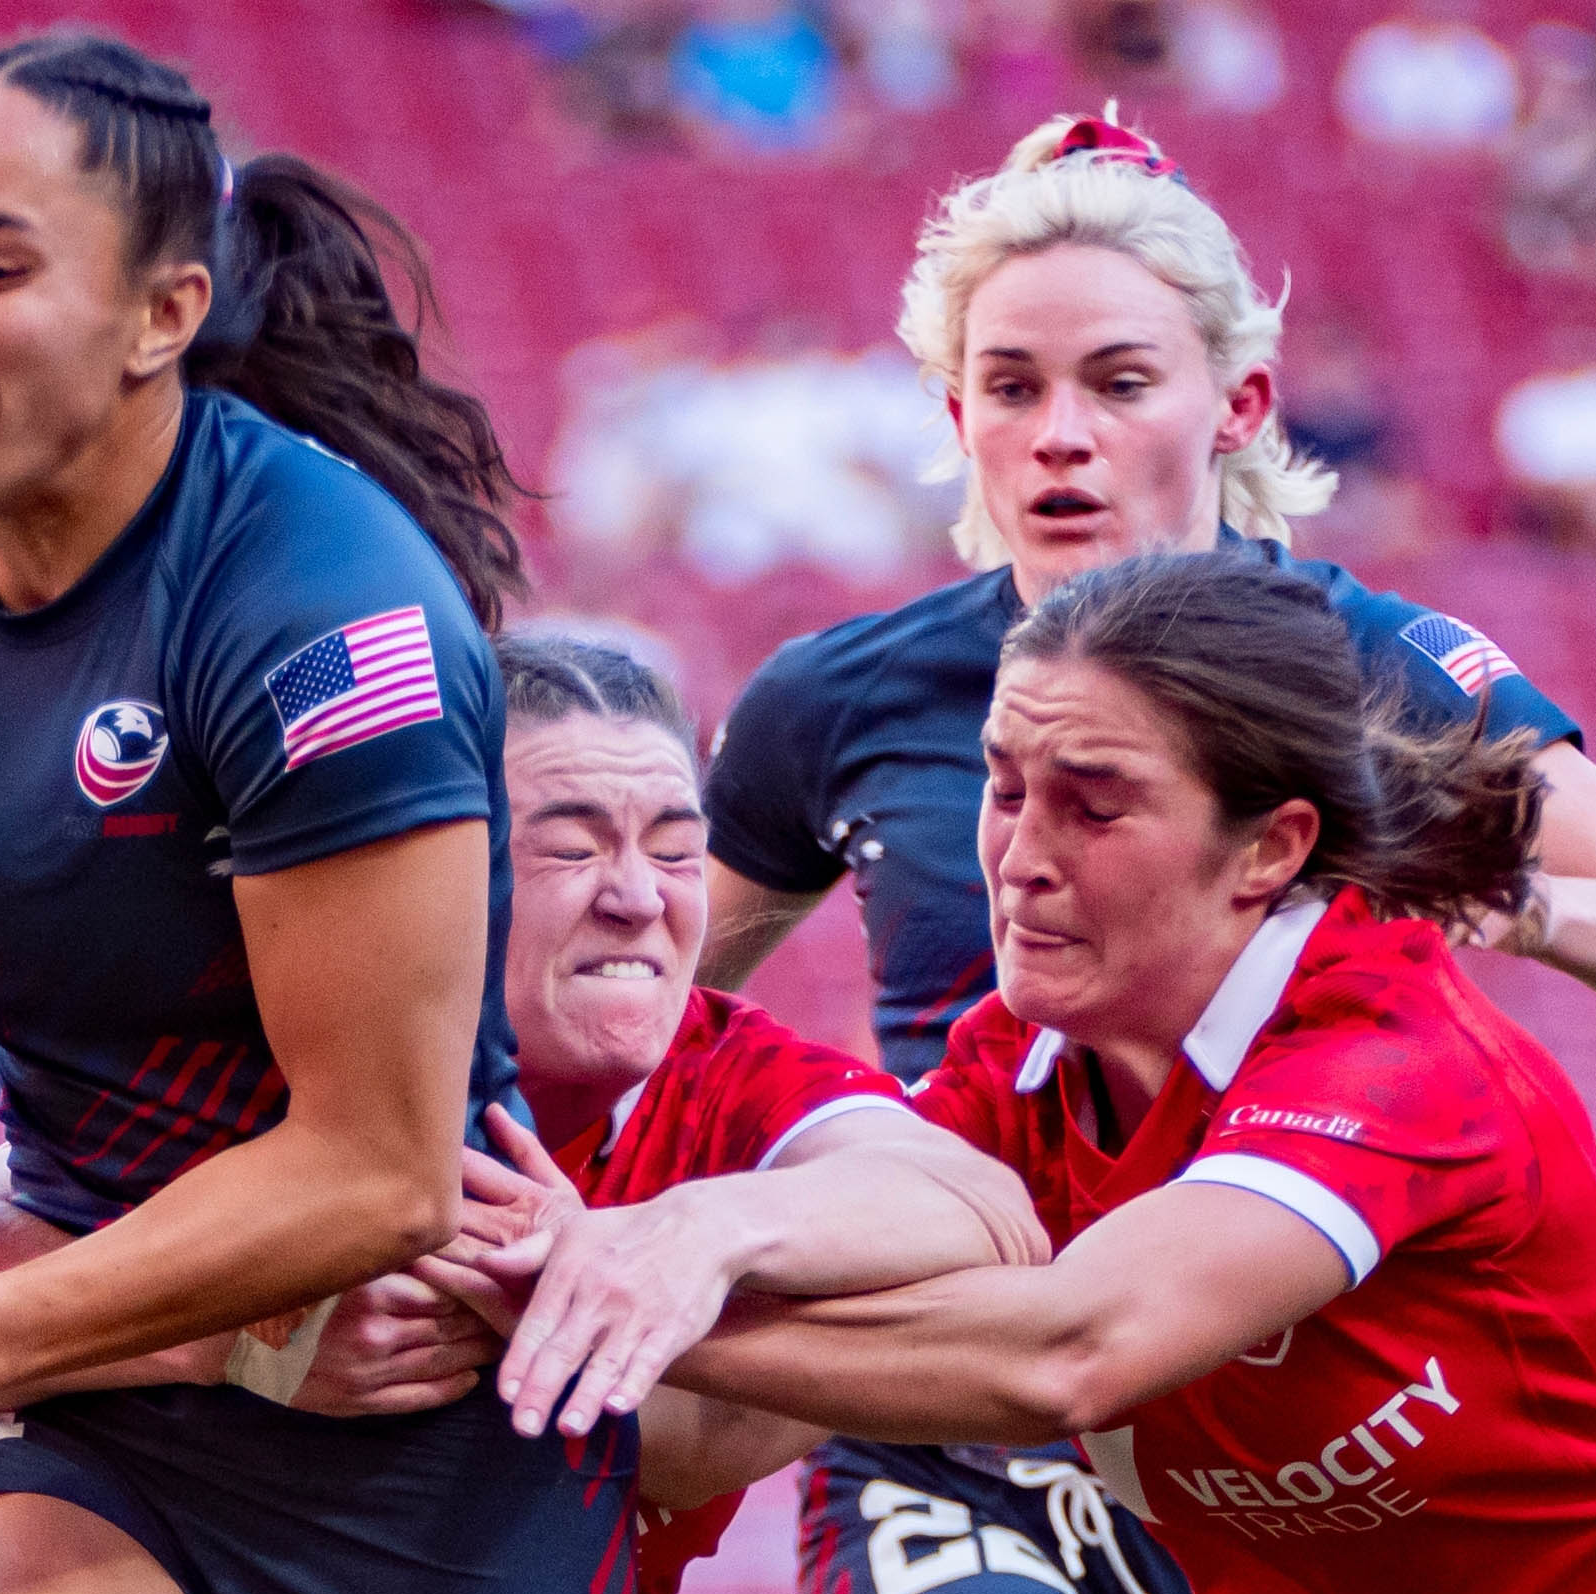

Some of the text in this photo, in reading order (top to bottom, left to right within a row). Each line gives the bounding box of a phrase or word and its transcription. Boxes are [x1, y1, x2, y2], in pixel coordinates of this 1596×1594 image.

[1228, 1104, 1360, 1141] Canada
[1165, 1356, 1461, 1507] VELOCITY
[1207, 1478, 1428, 1540] TRADE
